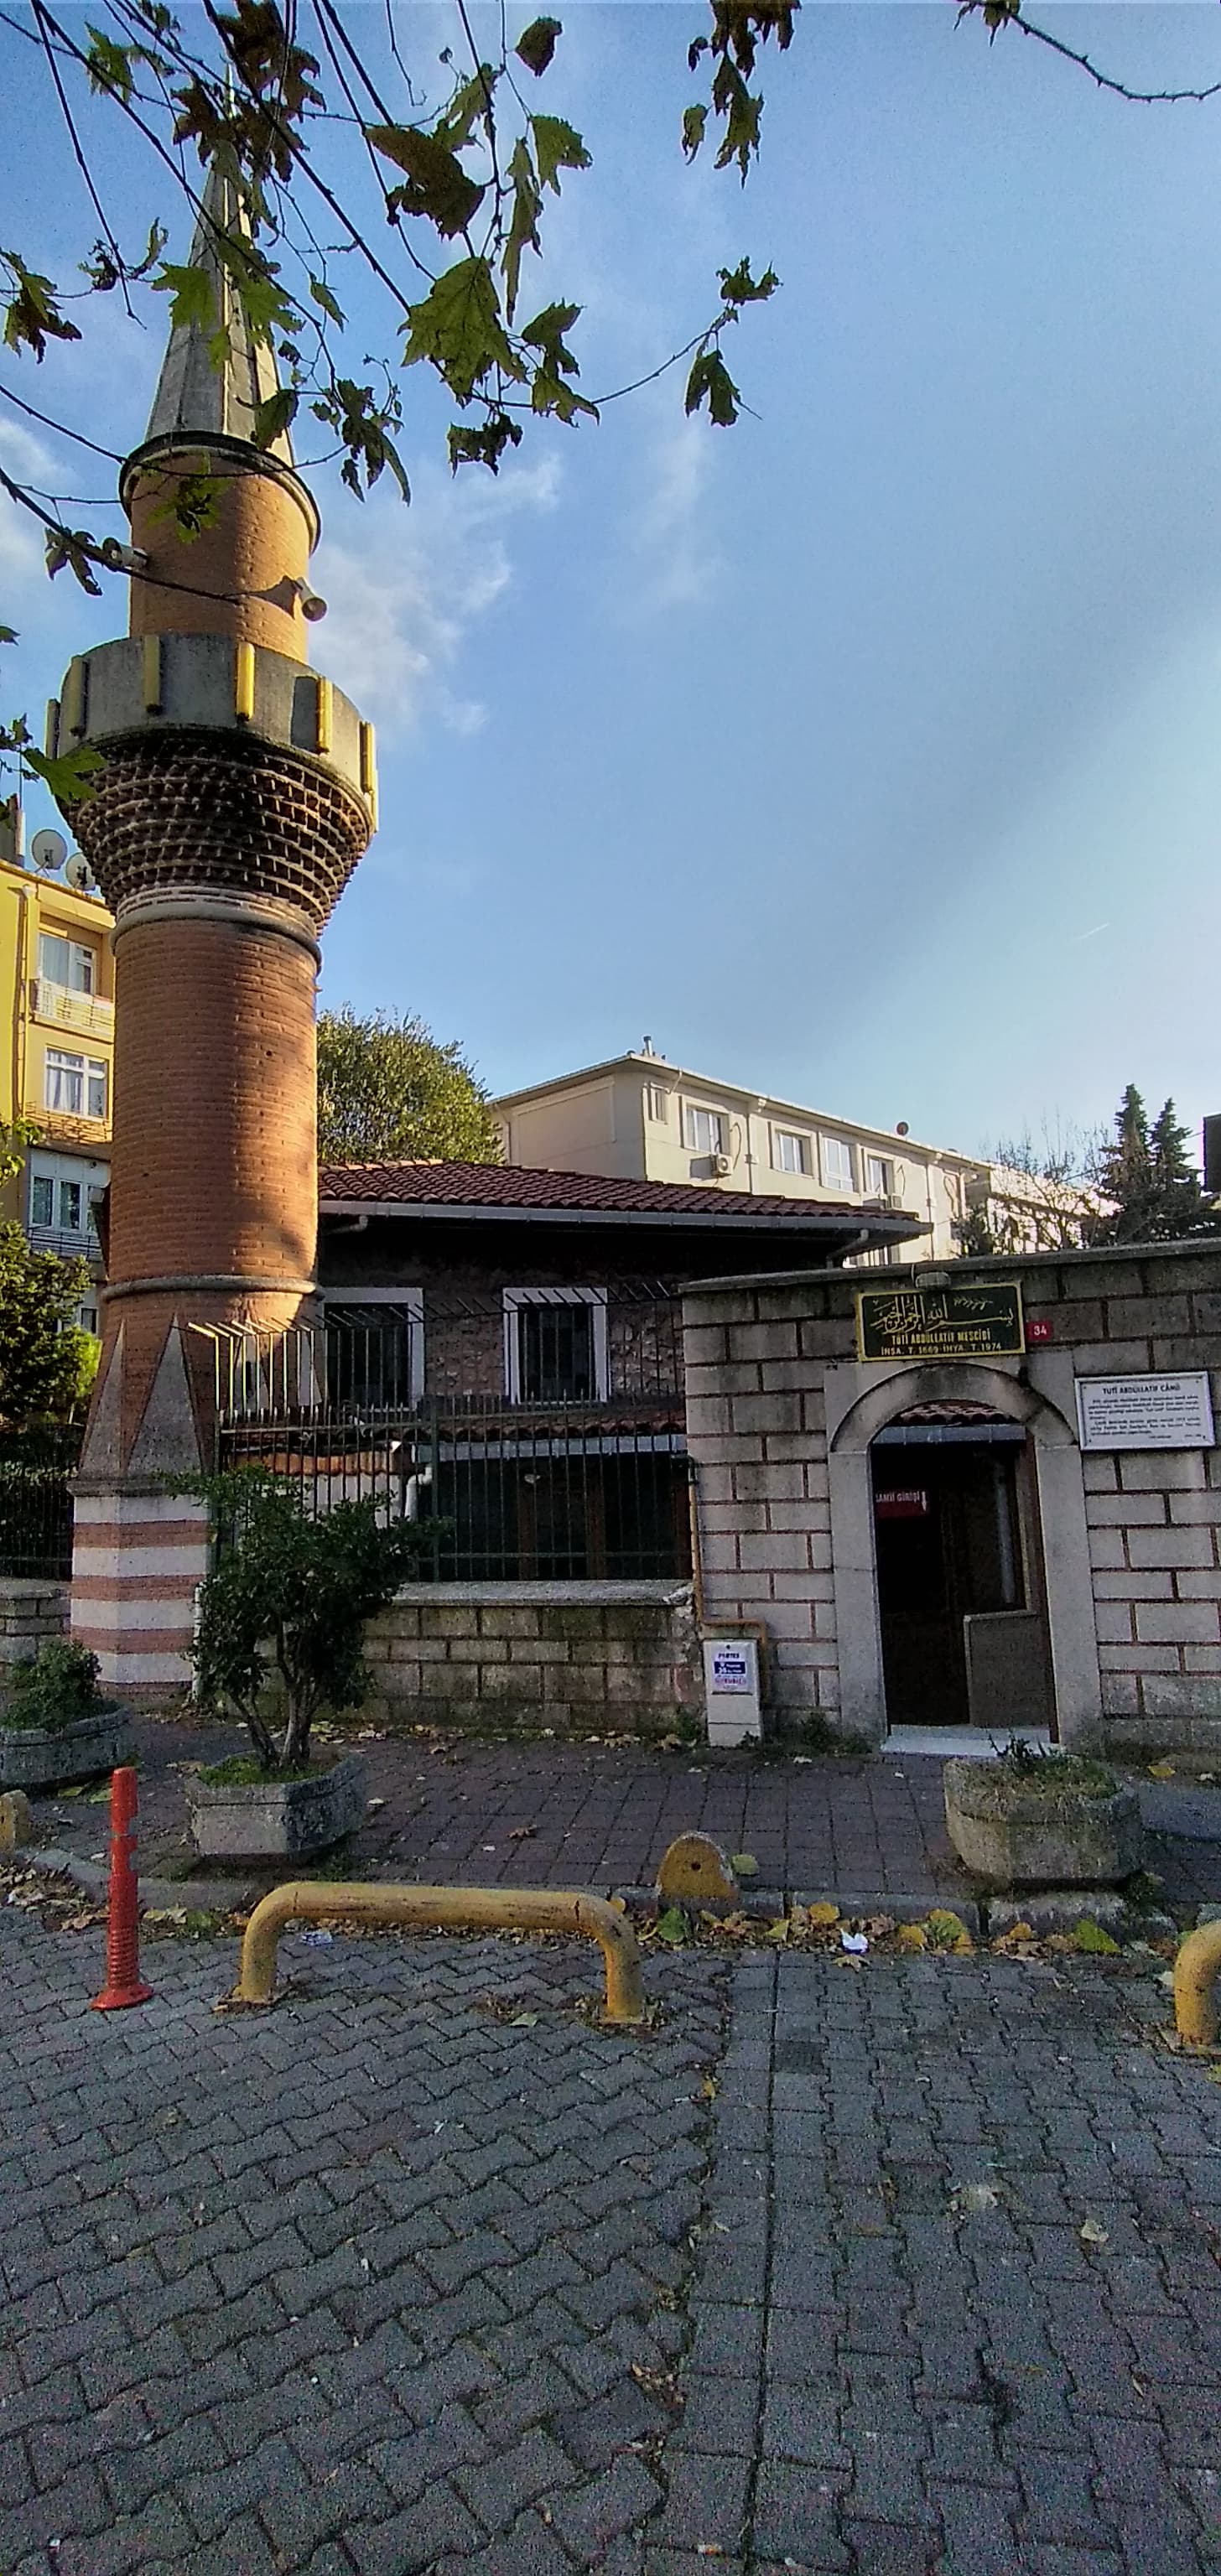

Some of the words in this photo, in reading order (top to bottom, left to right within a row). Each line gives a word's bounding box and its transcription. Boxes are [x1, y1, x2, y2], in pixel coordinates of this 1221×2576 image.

[957, 1327, 990, 1342] MESCİDİ
[1034, 1325, 1047, 1336] 34
[981, 1342, 1001, 1351] 1974
